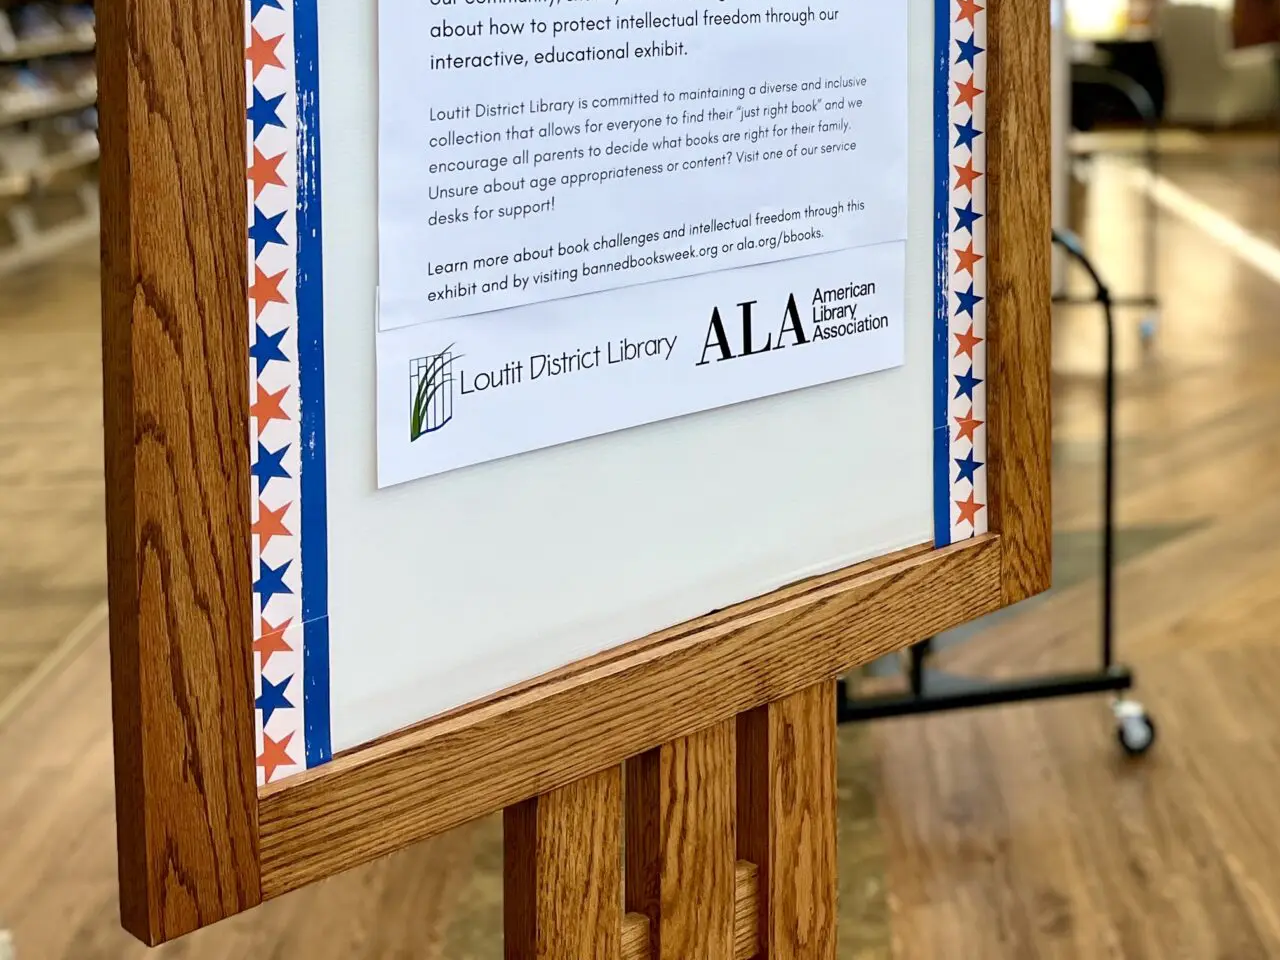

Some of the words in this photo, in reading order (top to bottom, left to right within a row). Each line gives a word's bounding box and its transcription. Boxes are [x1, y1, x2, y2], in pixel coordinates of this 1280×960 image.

[430, 19, 484, 38] about
[490, 17, 525, 35] how
[530, 19, 547, 33] to
[552, 16, 612, 38] protect
[616, 10, 698, 30] intellectual
[703, 8, 761, 26] freedom
[765, 6, 815, 26] through
[819, 10, 839, 20] our
[430, 51, 528, 70] interactive,
[534, 42, 628, 64] educational
[634, 40, 688, 58] exhibit.
[430, 106, 470, 121] Loutit
[476, 102, 525, 118] District
[530, 98, 574, 114] Library
[578, 98, 588, 109] is
[592, 90, 658, 108] committed
[663, 91, 675, 102] to
[679, 88, 745, 100] maintaining
[749, 86, 756, 95] a
[760, 81, 798, 94] diverse
[801, 77, 821, 91] and
[825, 76, 866, 88] inclusive
[428, 208, 469, 226] desks
[473, 205, 494, 220] for
[498, 196, 554, 220] support!
[428, 261, 468, 276] Learn
[473, 255, 509, 270] more
[513, 245, 554, 263] about
[558, 238, 590, 256] book
[593, 232, 660, 250] challenges
[662, 224, 685, 239] and
[689, 214, 752, 236] intellectual
[755, 209, 801, 226] freedom
[804, 201, 844, 218] through
[847, 199, 864, 212] this
[428, 282, 477, 302] exhibit
[482, 274, 508, 293] and
[513, 274, 529, 290] by
[533, 269, 578, 284] visiting
[582, 245, 718, 276] bannedbooksweek.org
[722, 244, 734, 253] or
[737, 226, 824, 250] ala.org/bbooks.
[811, 280, 876, 305] American
[695, 292, 810, 365] ALA
[811, 313, 889, 342] Association
[812, 302, 858, 324] Library
[460, 362, 523, 395] Loutit
[530, 345, 601, 379] District
[608, 334, 678, 365] Library
